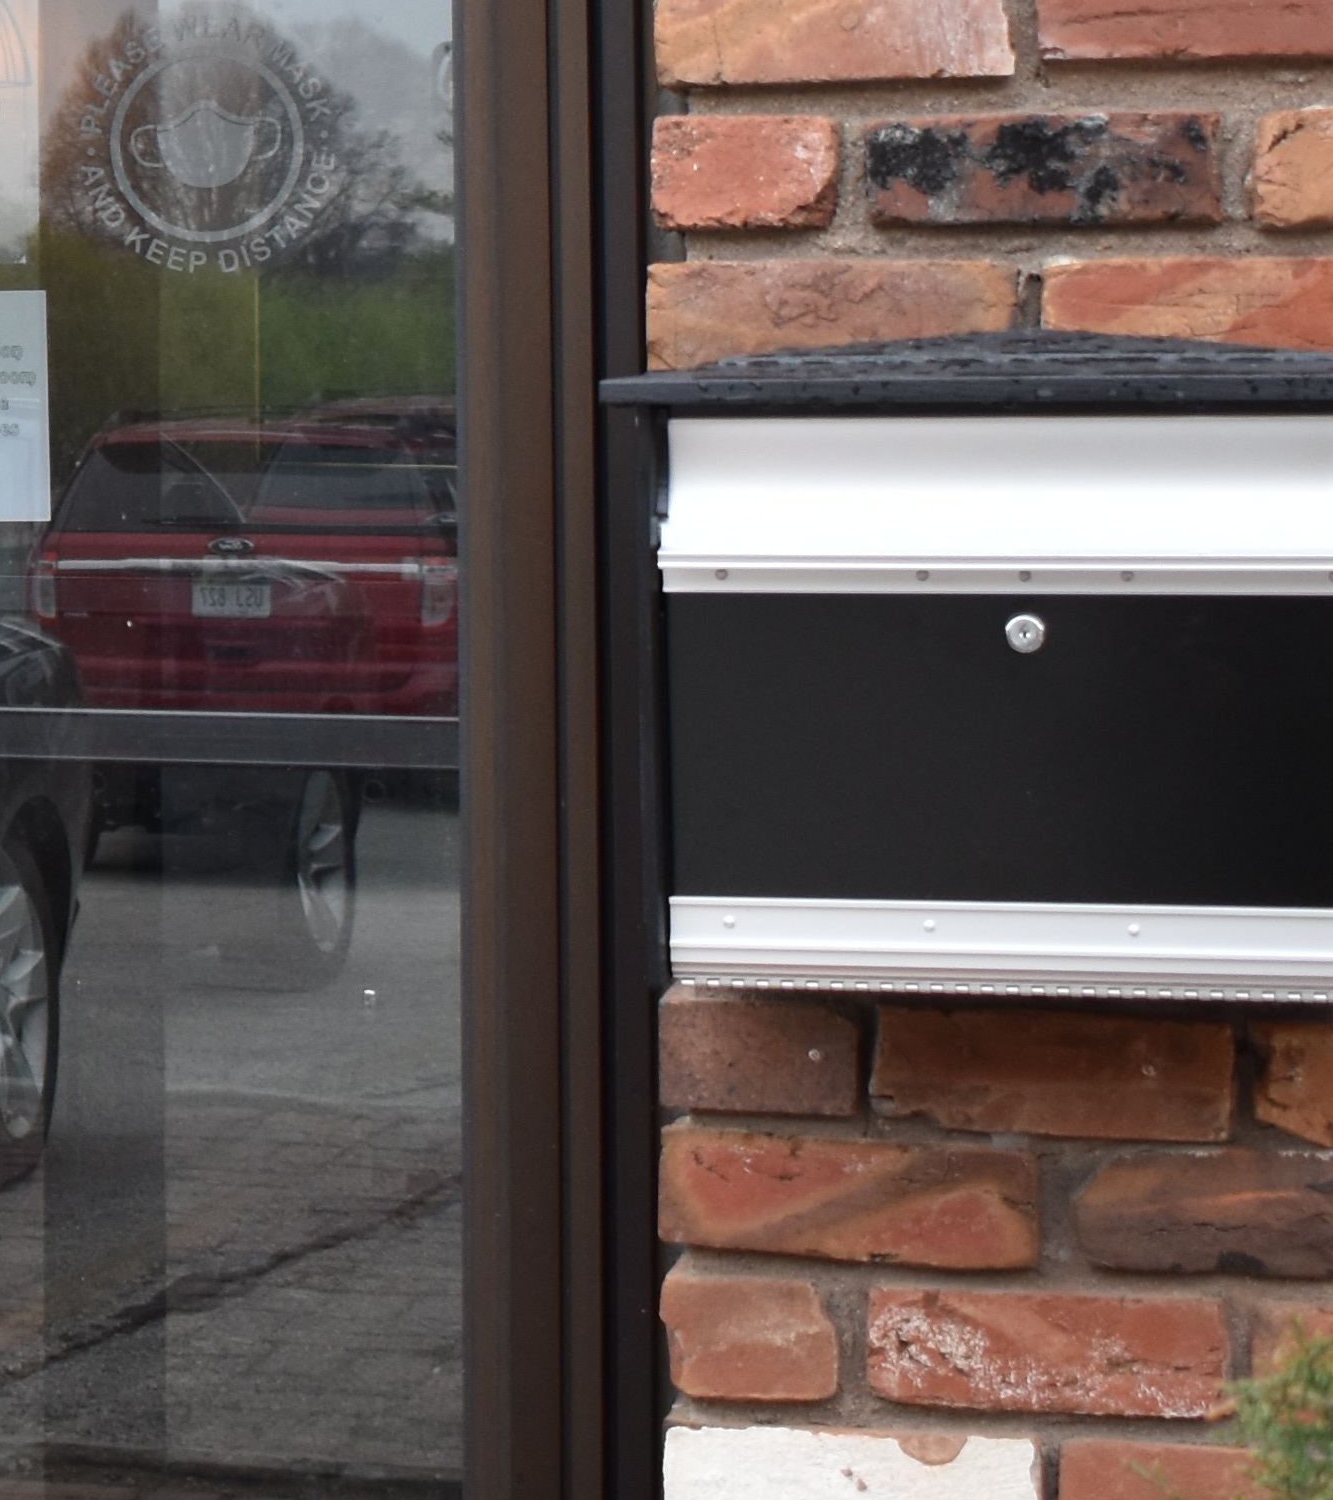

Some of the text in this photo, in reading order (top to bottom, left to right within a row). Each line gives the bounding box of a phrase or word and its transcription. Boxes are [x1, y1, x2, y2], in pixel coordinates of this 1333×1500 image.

[80, 16, 334, 139] PLEASE WEAR MASK
[80, 151, 336, 274] AND KEEP DISTANCE
